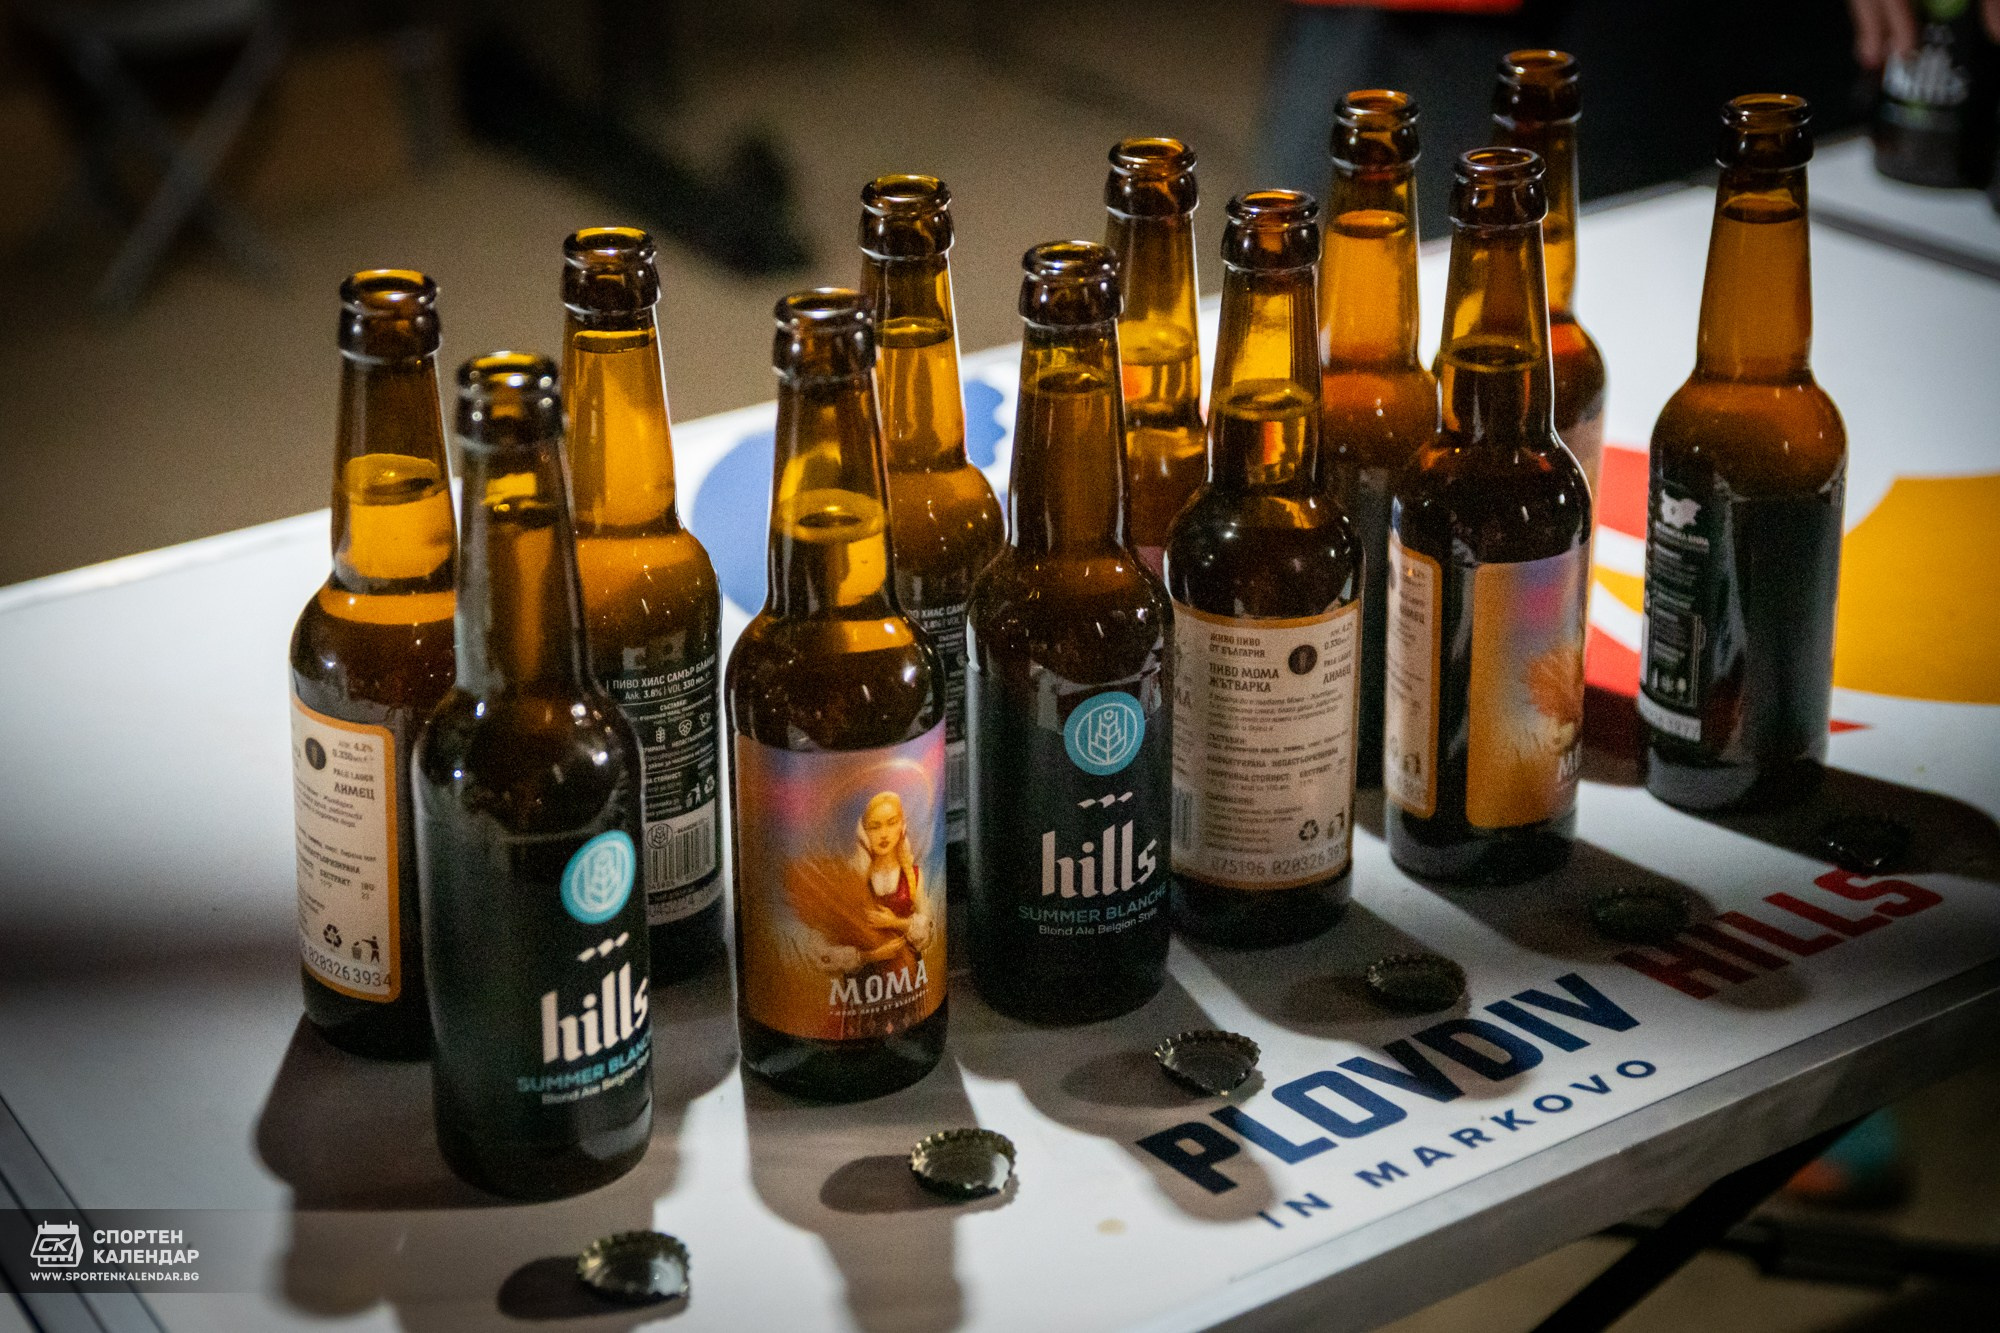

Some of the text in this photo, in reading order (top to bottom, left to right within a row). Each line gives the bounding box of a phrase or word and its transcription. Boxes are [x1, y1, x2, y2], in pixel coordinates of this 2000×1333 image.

[1236, 636, 1260, 647] ПИВО
[613, 679, 639, 690] ПИВО
[641, 675, 666, 688] ХИЛС
[667, 665, 695, 684] САМЪР
[1209, 662, 1280, 680] ПИВО МОМА
[683, 679, 695, 691] 330
[1041, 818, 1158, 899] hills
[1017, 904, 1101, 924] SUMMER
[1038, 924, 1074, 936] Blond
[1075, 925, 1096, 936] Ale
[1098, 916, 1138, 935] Belgian
[352, 967, 392, 987] 3934
[541, 961, 650, 1065] hills
[1135, 862, 1944, 1196] PLOVDIV HILLS
[516, 1062, 607, 1094] SUMMER
[1257, 1058, 1657, 1230] IN MARKOVO
